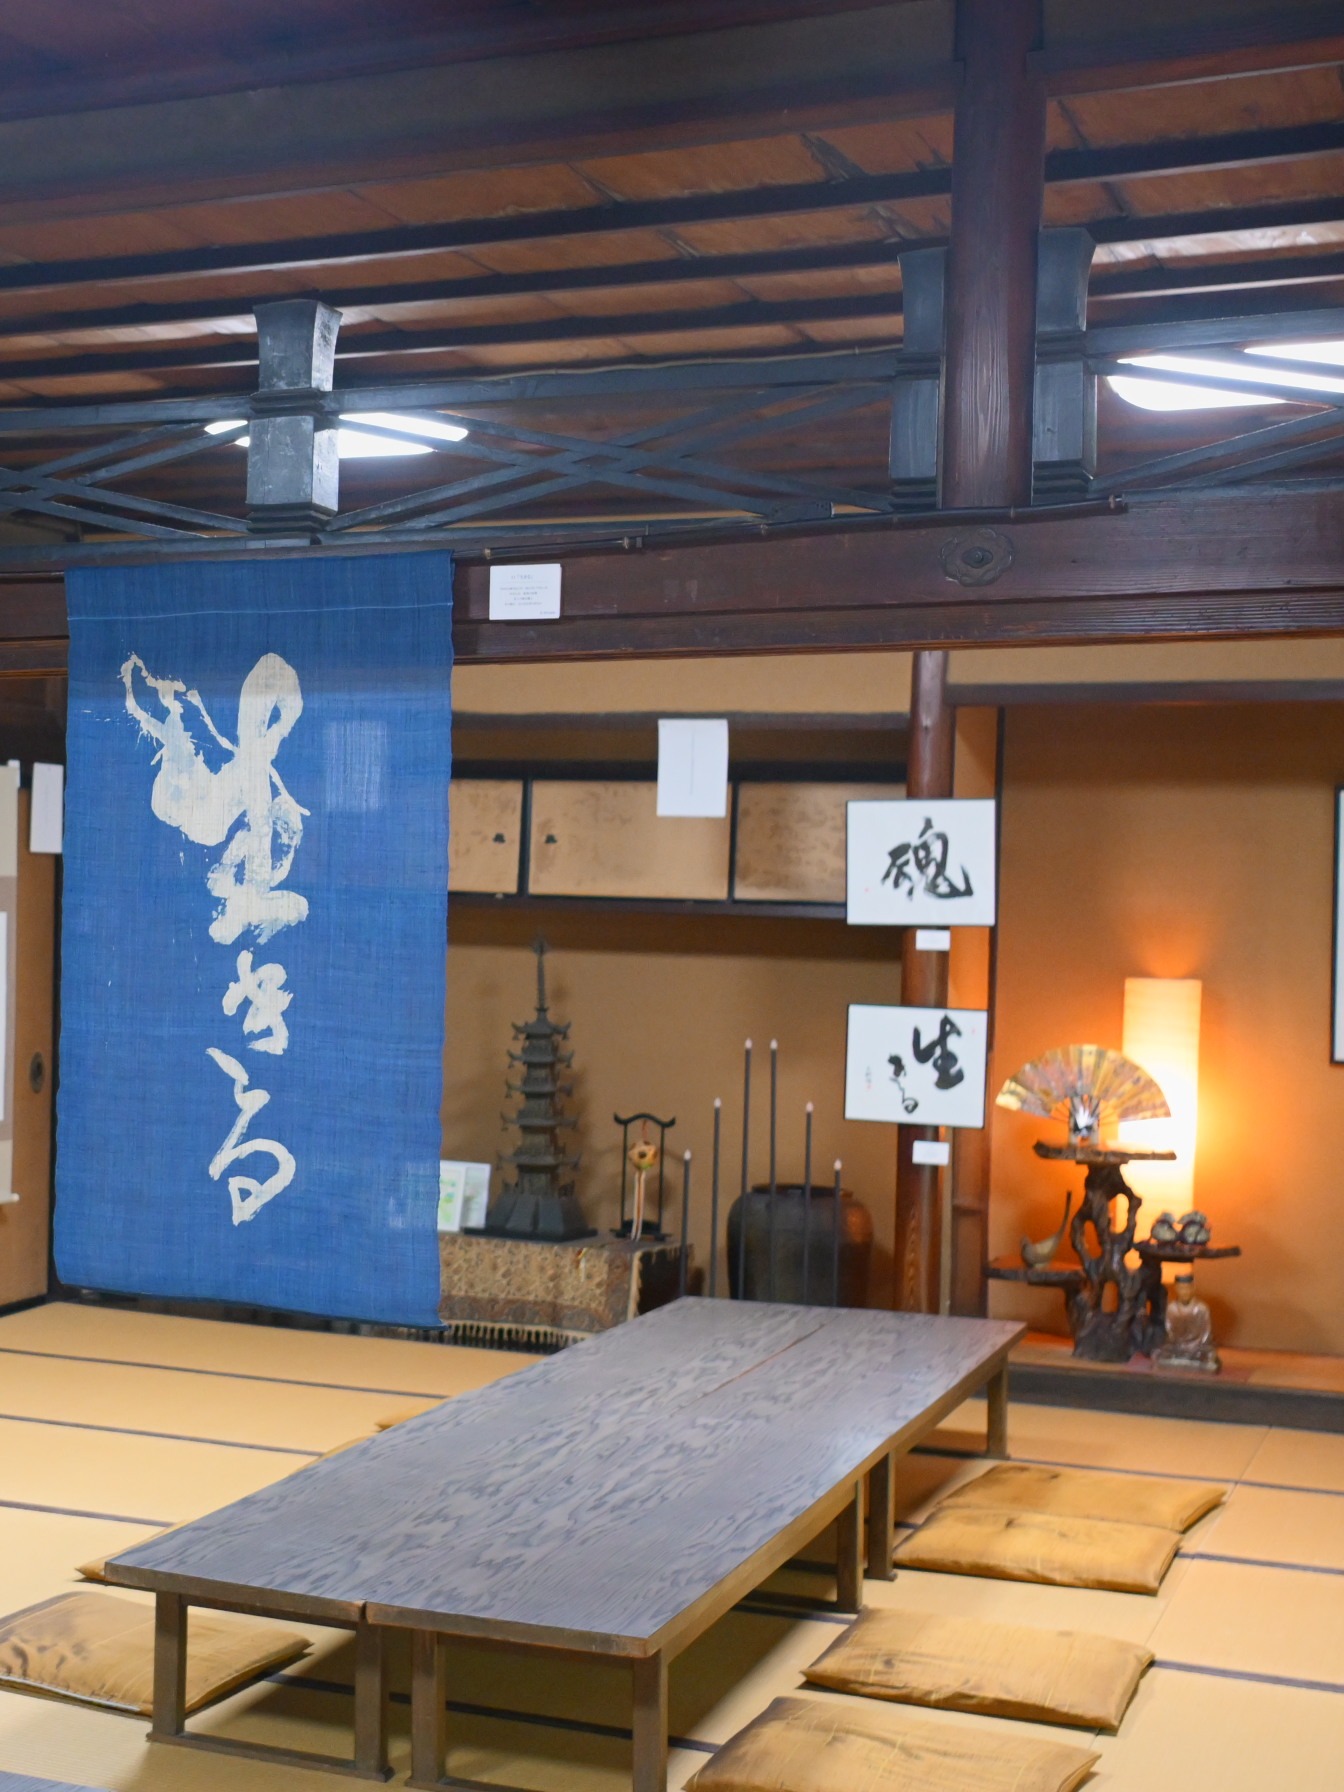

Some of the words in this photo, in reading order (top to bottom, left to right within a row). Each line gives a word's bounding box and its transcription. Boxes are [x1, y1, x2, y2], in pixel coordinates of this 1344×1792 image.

[119, 652, 310, 1226] 生きる
[881, 816, 974, 902] 魂
